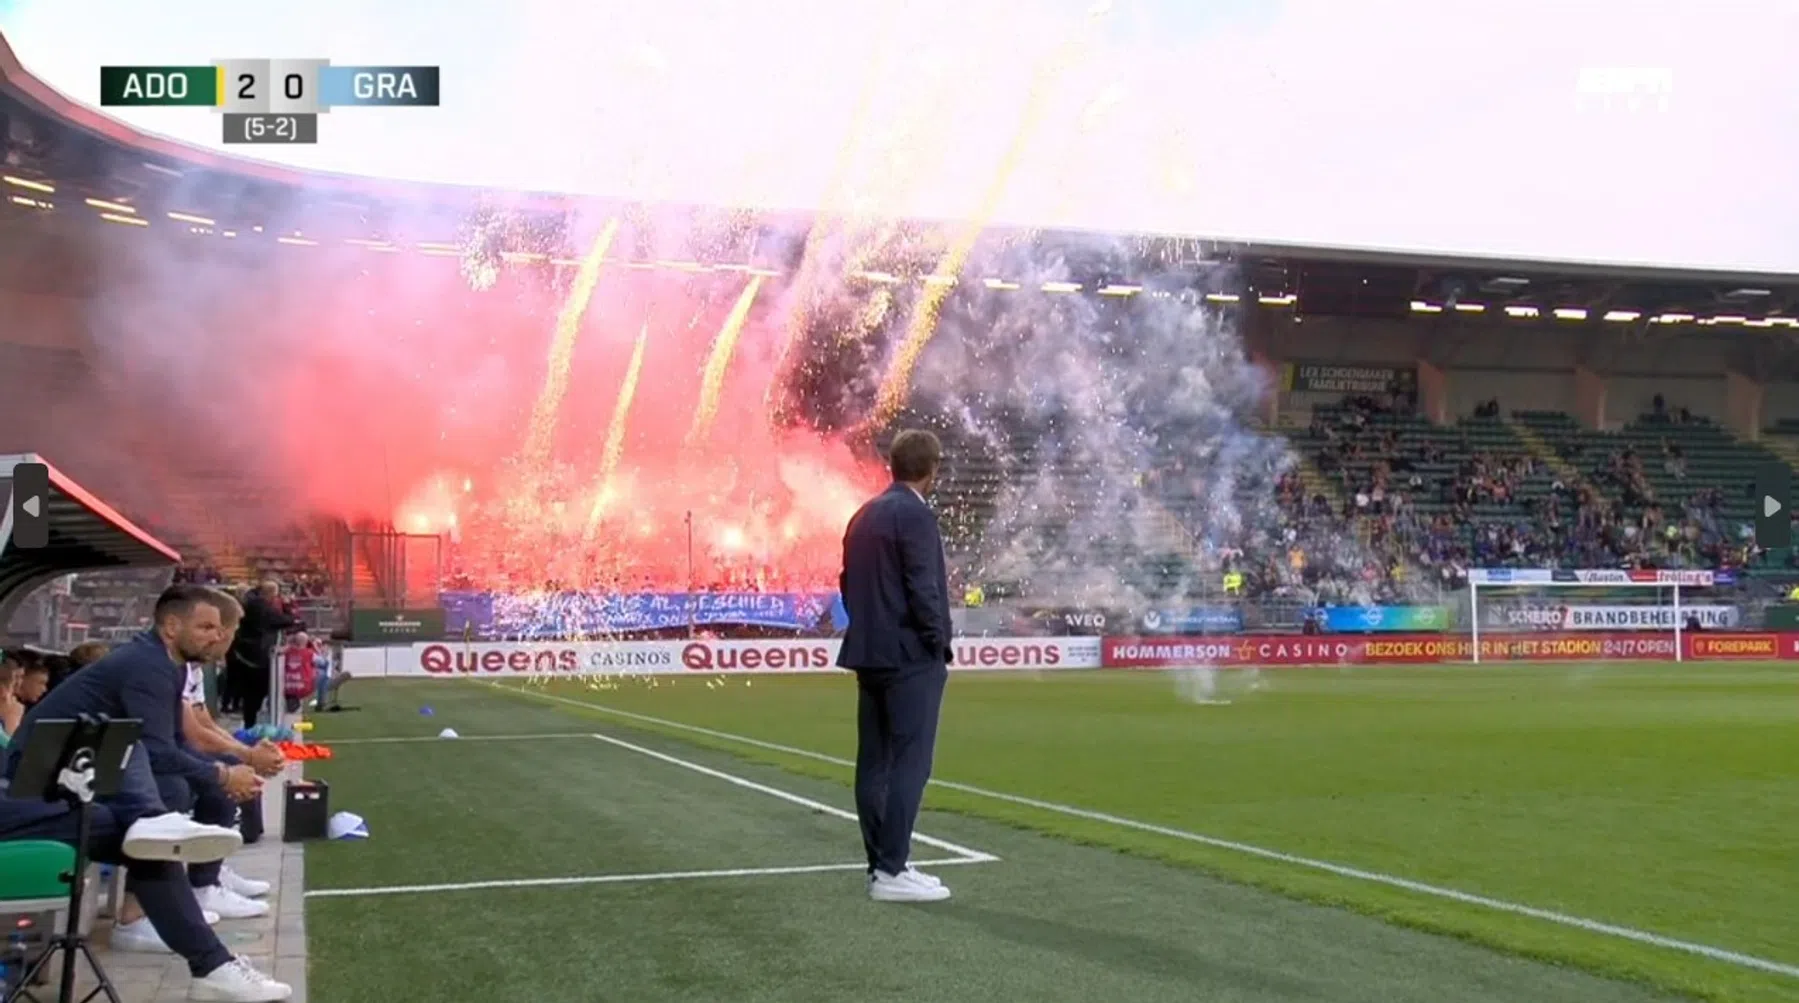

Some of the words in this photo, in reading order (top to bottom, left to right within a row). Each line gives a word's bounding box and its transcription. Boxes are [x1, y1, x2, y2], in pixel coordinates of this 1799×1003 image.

[1112, 644, 1231, 659] HOMMERSON
[1259, 642, 1349, 658] CASINO
[1365, 642, 1423, 657] BEZOEK
[1425, 642, 1456, 656] ONS
[1494, 641, 1508, 655] IN
[1541, 640, 1600, 655] STADION
[1604, 640, 1635, 656] 24/7
[1637, 640, 1674, 654] OPEN
[1708, 640, 1773, 653] FOREPARK
[420, 644, 577, 674] Queens
[591, 650, 672, 667] CASINO'S
[682, 643, 829, 669] Queens
[953, 644, 1061, 667] ueens
